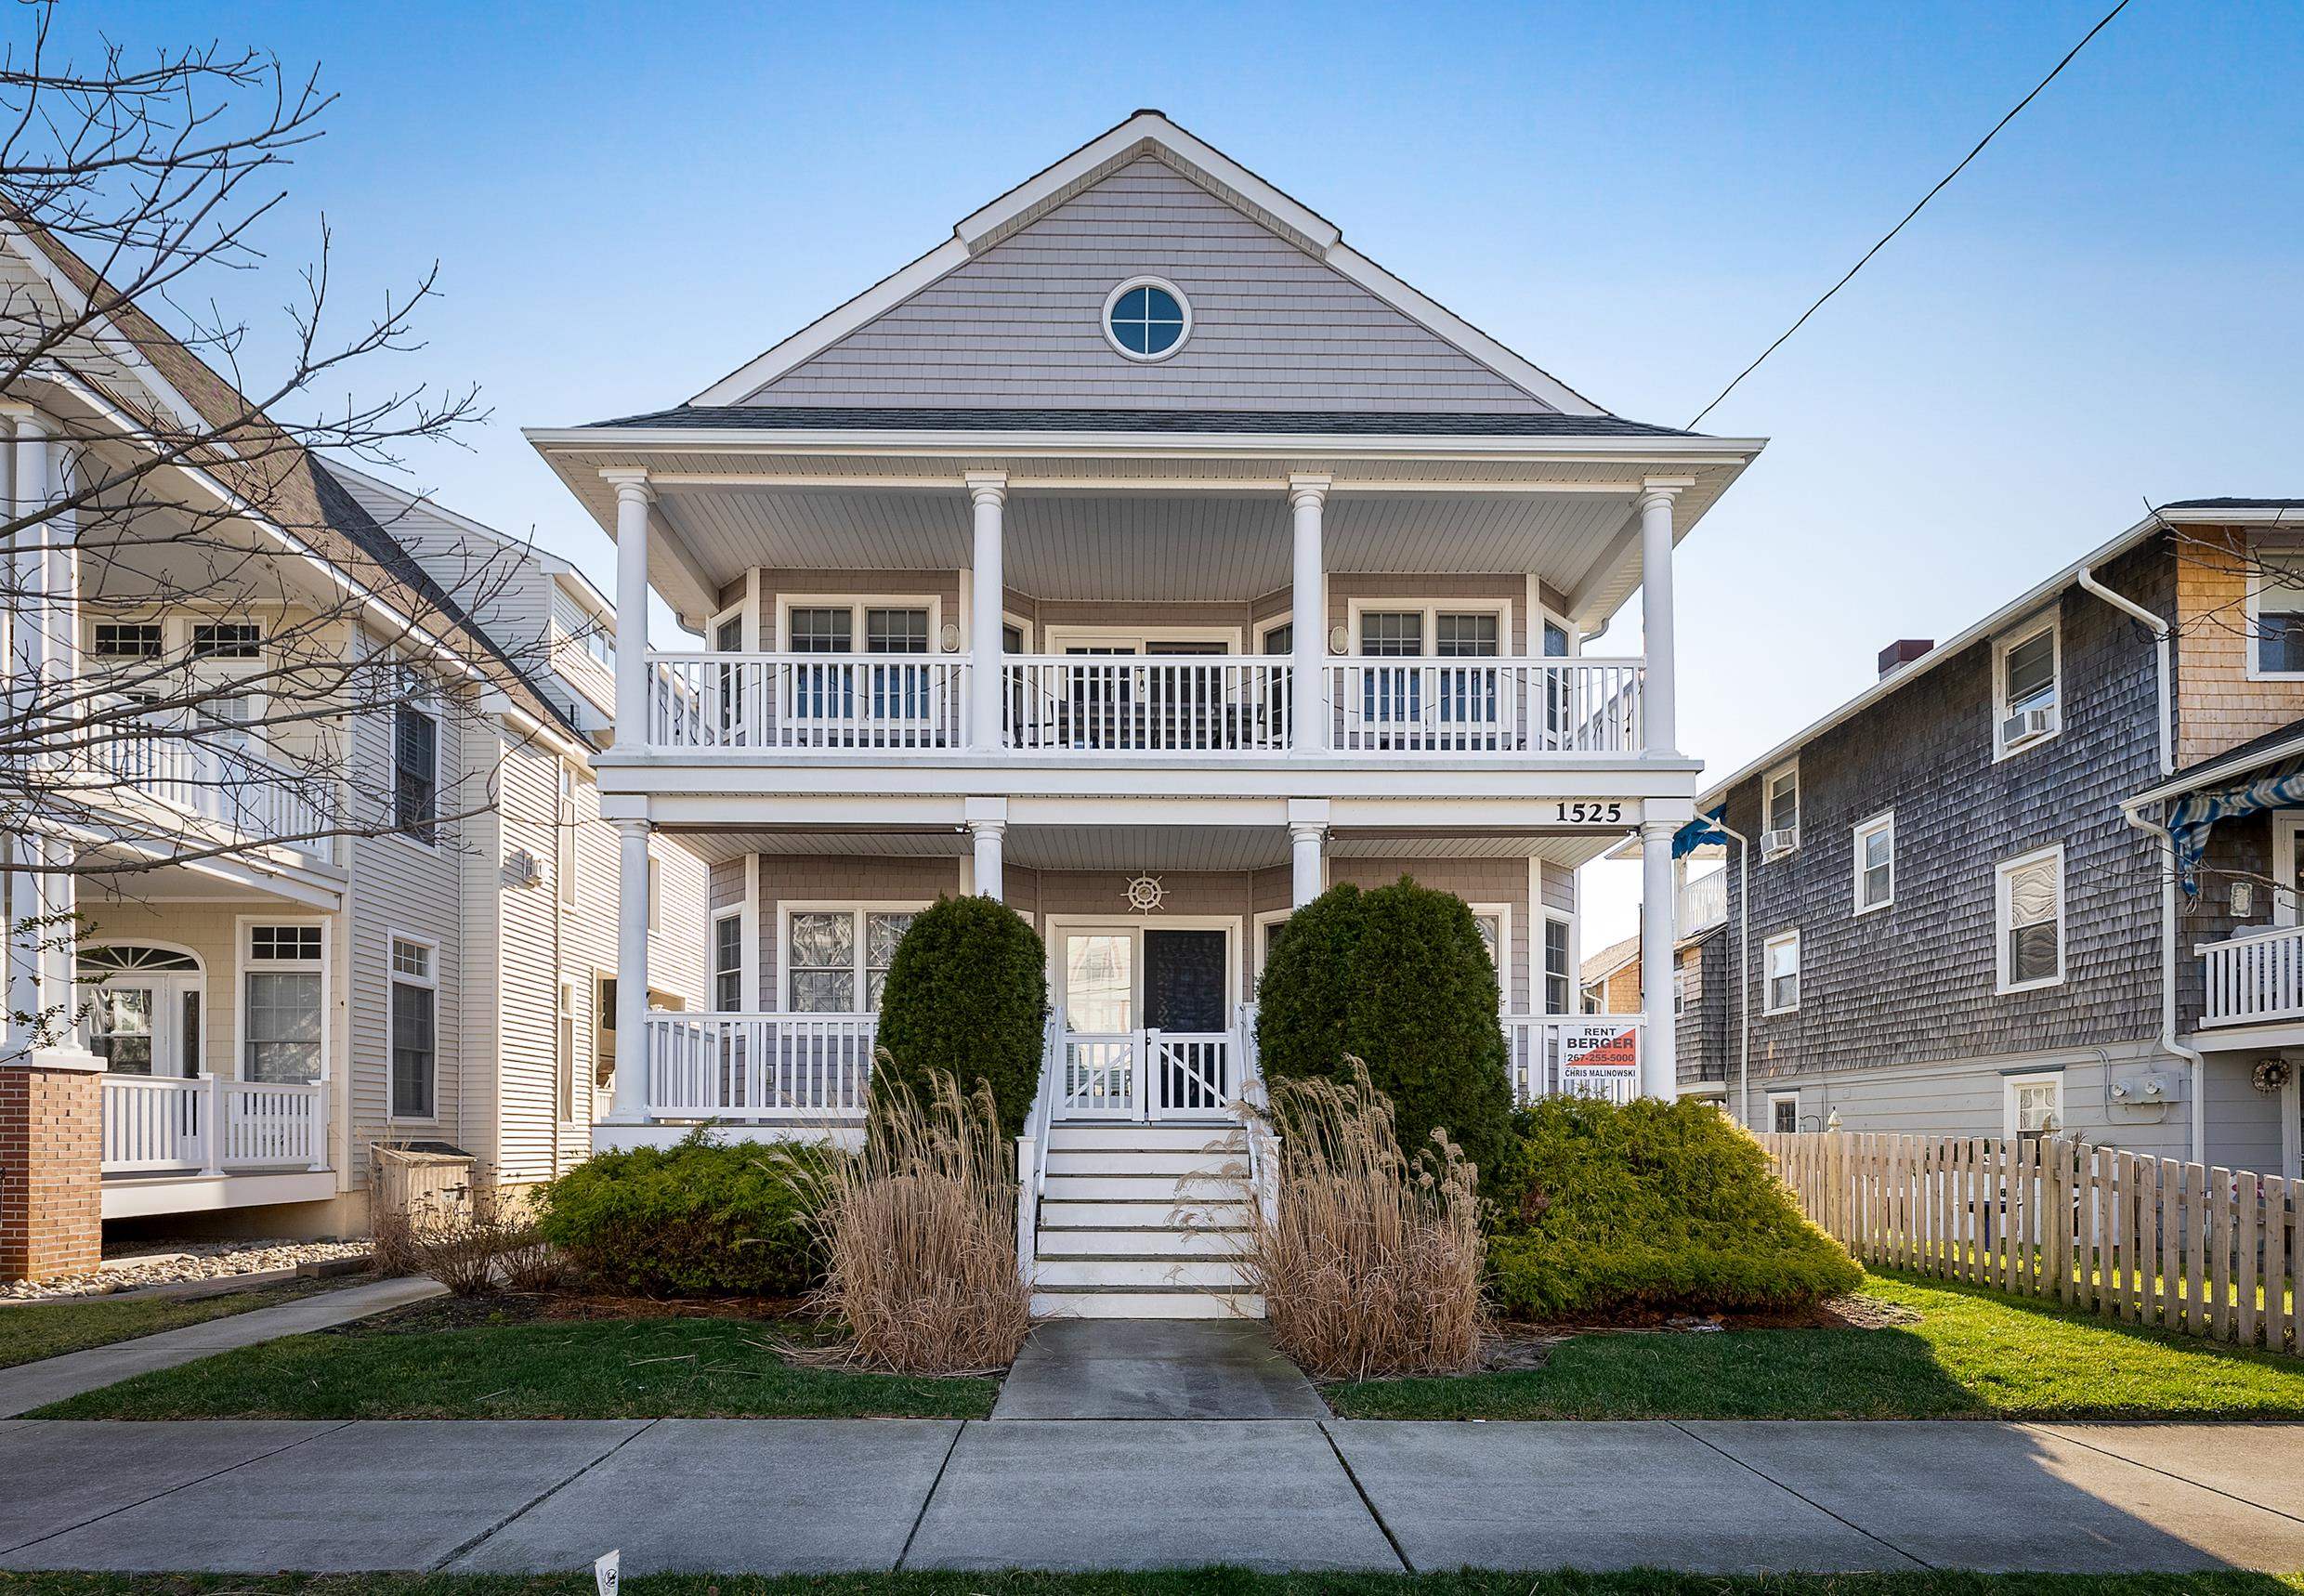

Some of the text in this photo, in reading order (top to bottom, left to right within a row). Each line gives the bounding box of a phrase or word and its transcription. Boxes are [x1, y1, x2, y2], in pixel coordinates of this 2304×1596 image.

[1556, 802, 1622, 823] 1525
[1584, 1027, 1617, 1037] RENT
[1566, 1038, 1634, 1049] BERGER
[1567, 1053, 1634, 1062] 267-255-5000
[1564, 1069, 1636, 1078] CHRIS MALINOWSKI
